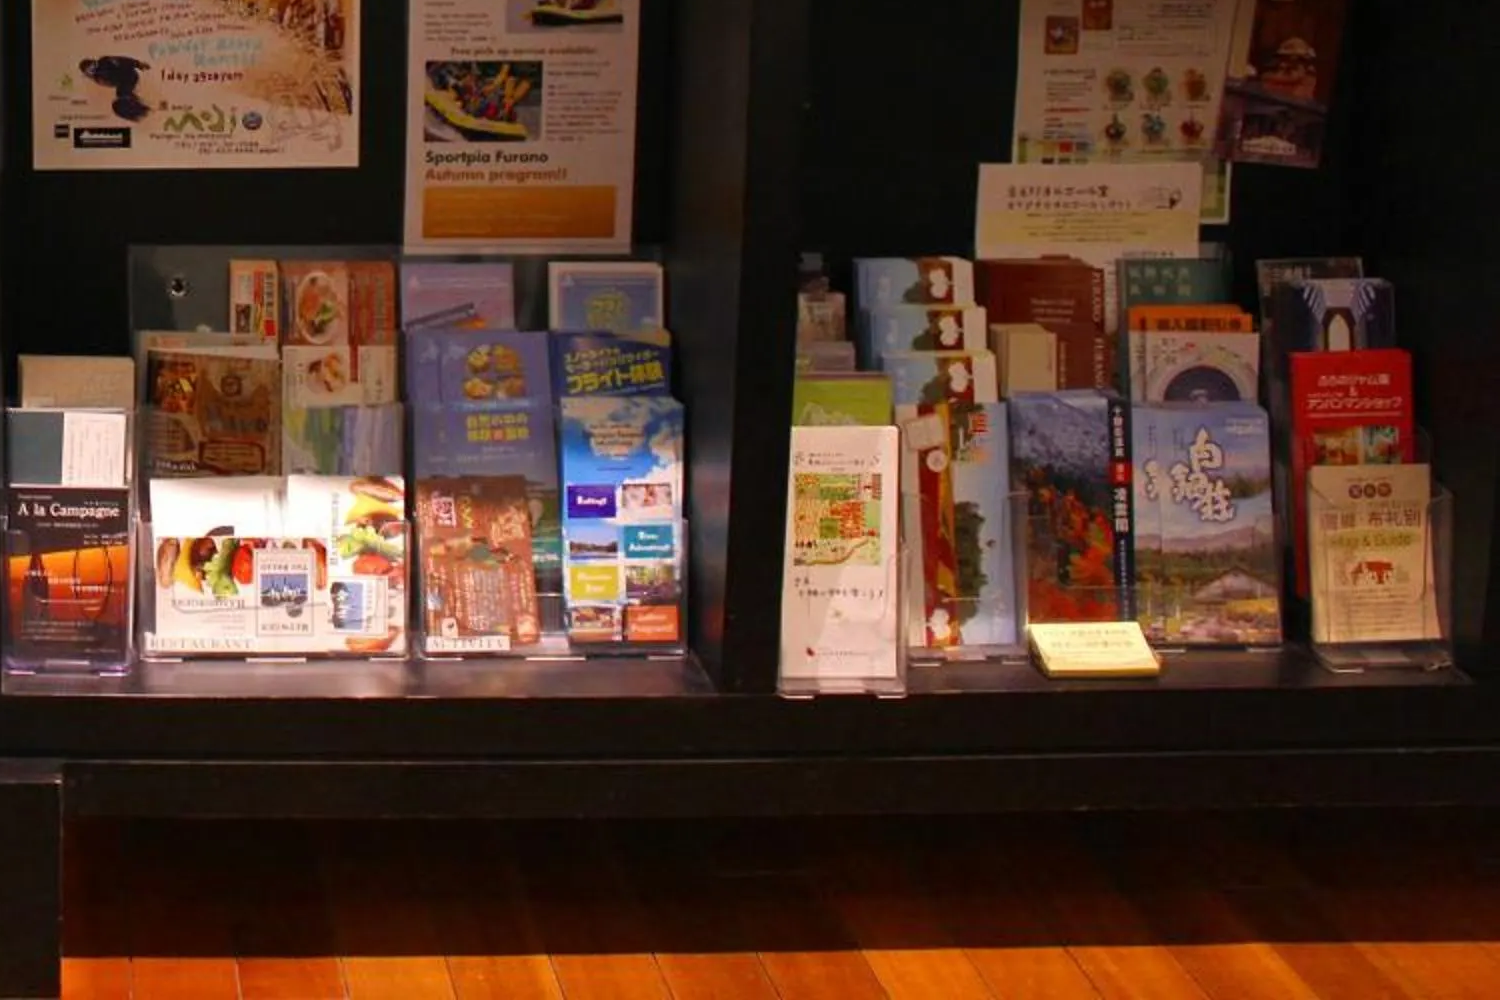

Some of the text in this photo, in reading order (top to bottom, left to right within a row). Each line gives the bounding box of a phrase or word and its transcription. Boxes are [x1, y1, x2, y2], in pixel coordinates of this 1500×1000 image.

[425, 150, 491, 166] Sportpia
[17, 503, 121, 520] A la Campagne
